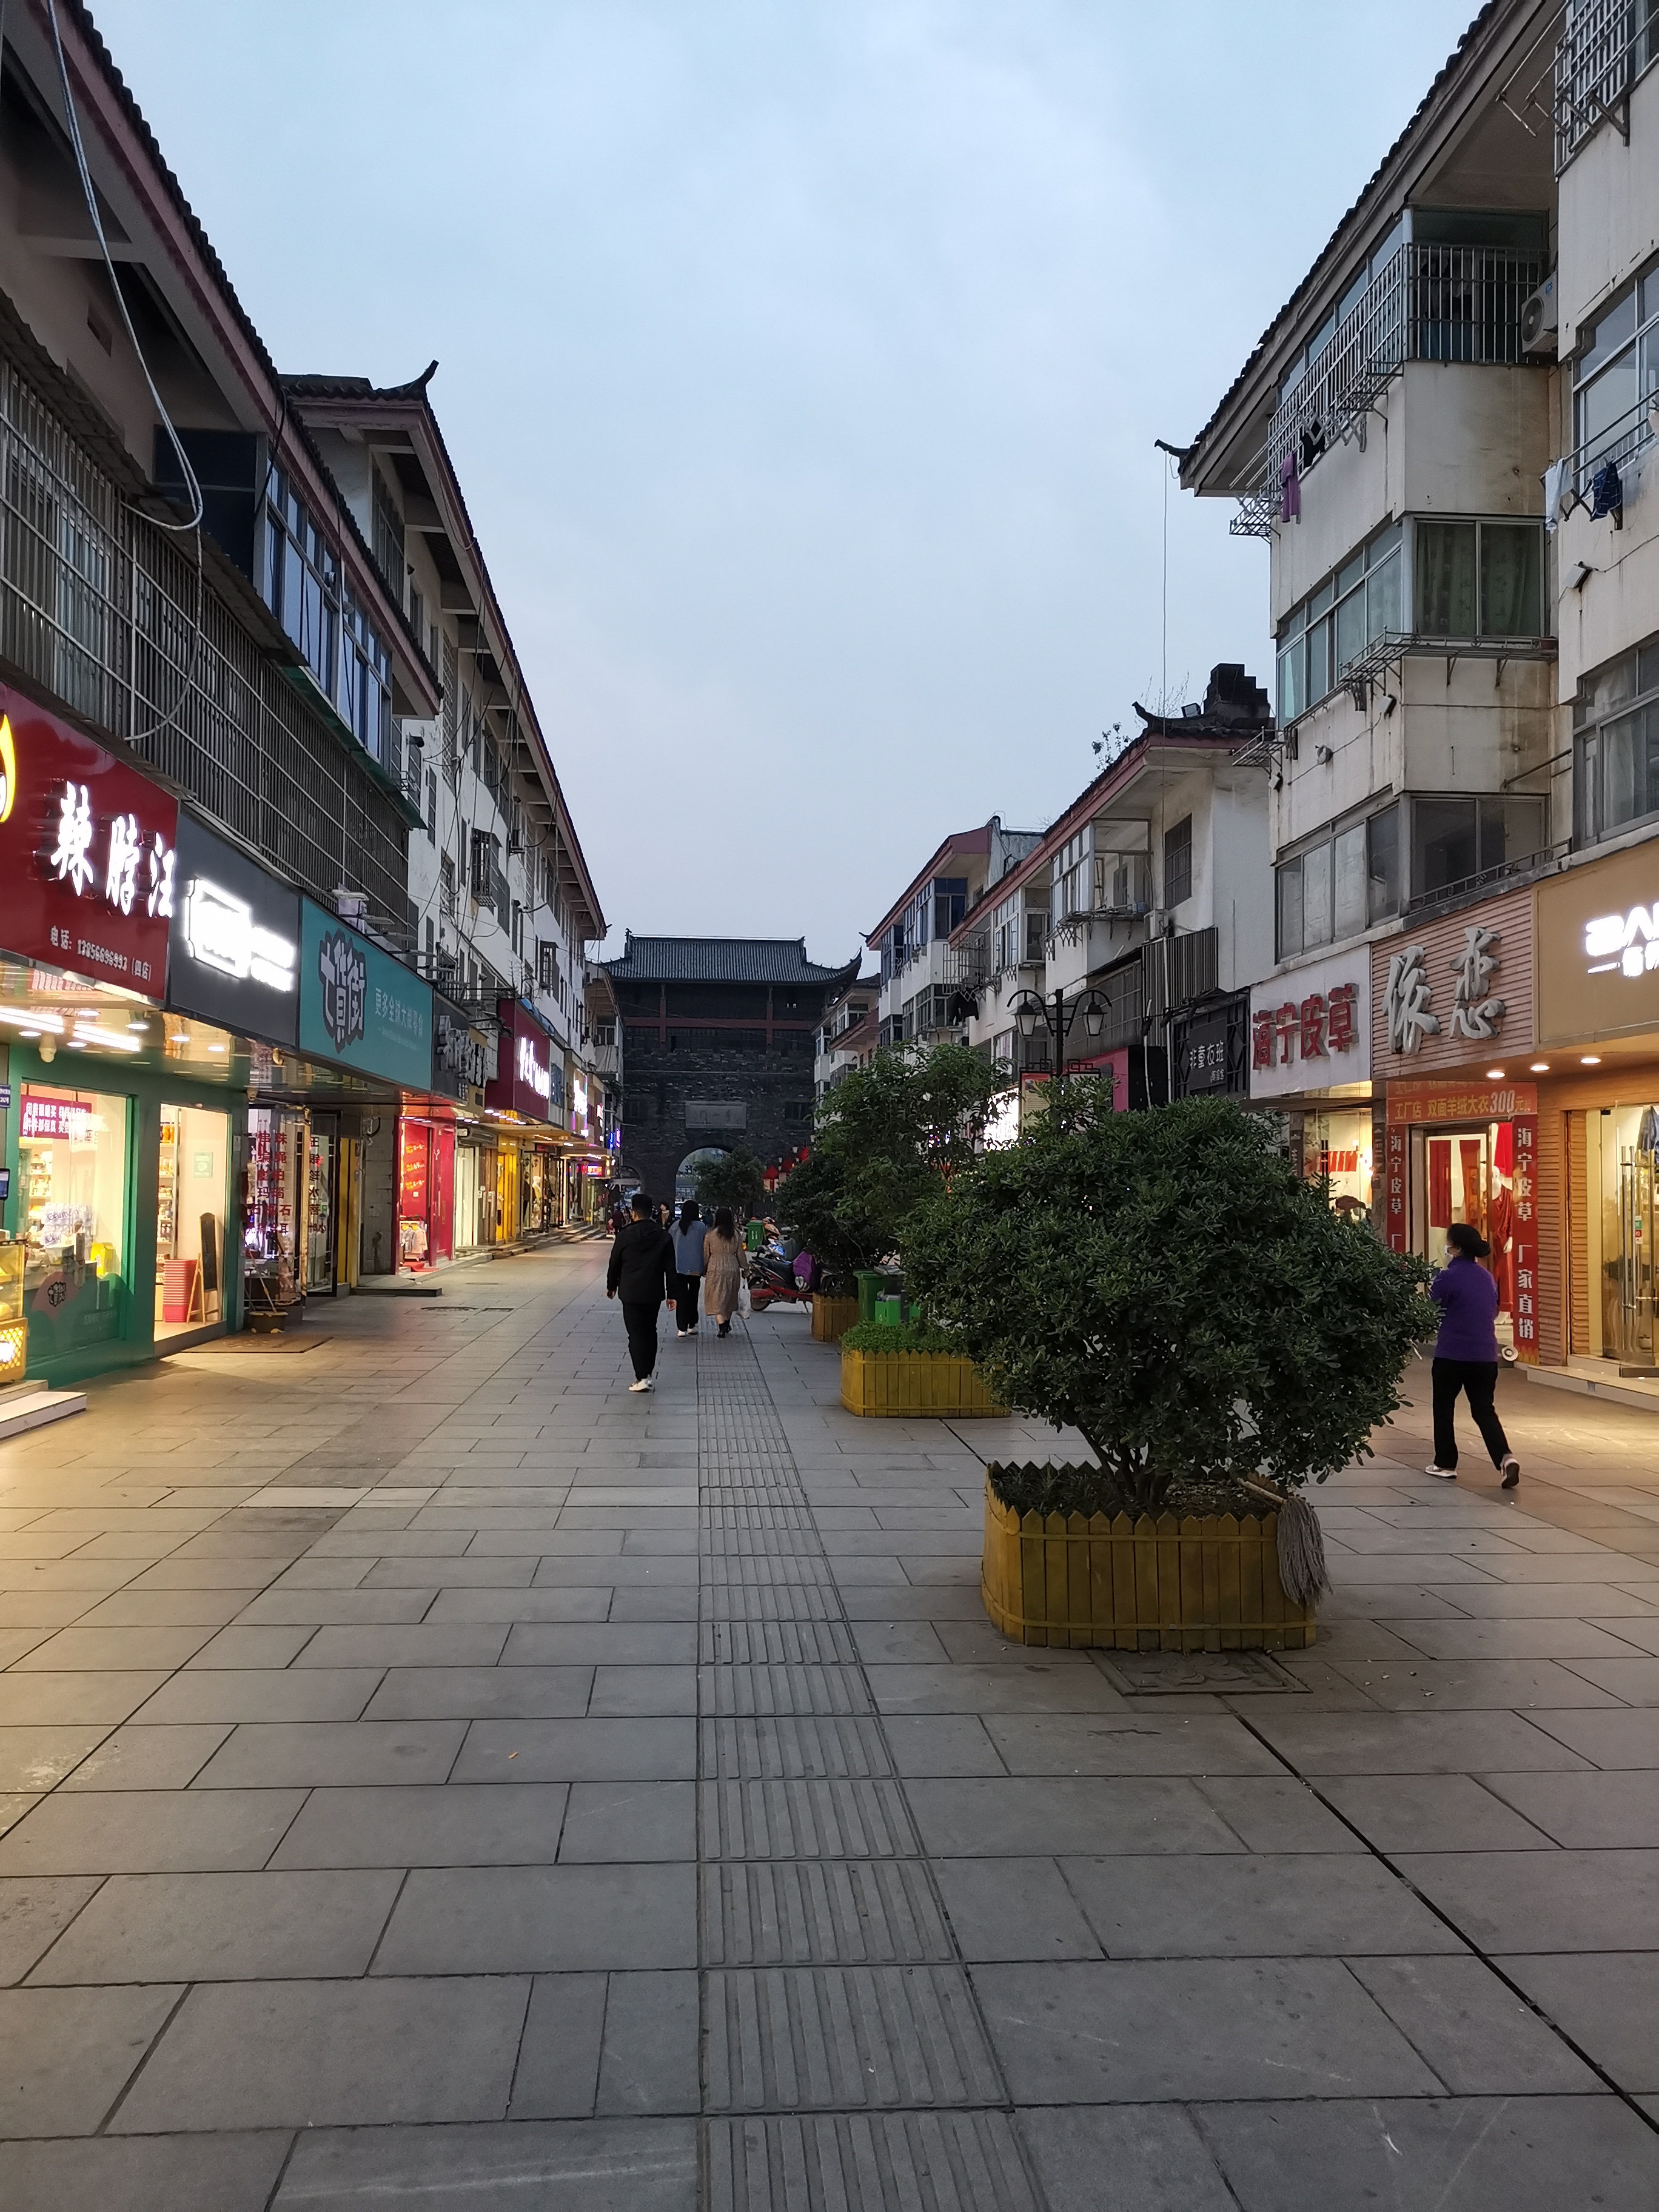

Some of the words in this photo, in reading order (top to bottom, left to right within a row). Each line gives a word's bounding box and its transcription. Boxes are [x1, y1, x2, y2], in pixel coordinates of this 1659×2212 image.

[1253, 983, 1359, 1070] 海宁皮草
[1395, 1101, 1422, 1120] 工厂店
[257, 1187, 284, 1199] 玛瑙
[1391, 1136, 1402, 1215] 海宁皮草
[1518, 1128, 1533, 1221] 海宁皮草
[1518, 1245, 1534, 1341] 厂家直销
